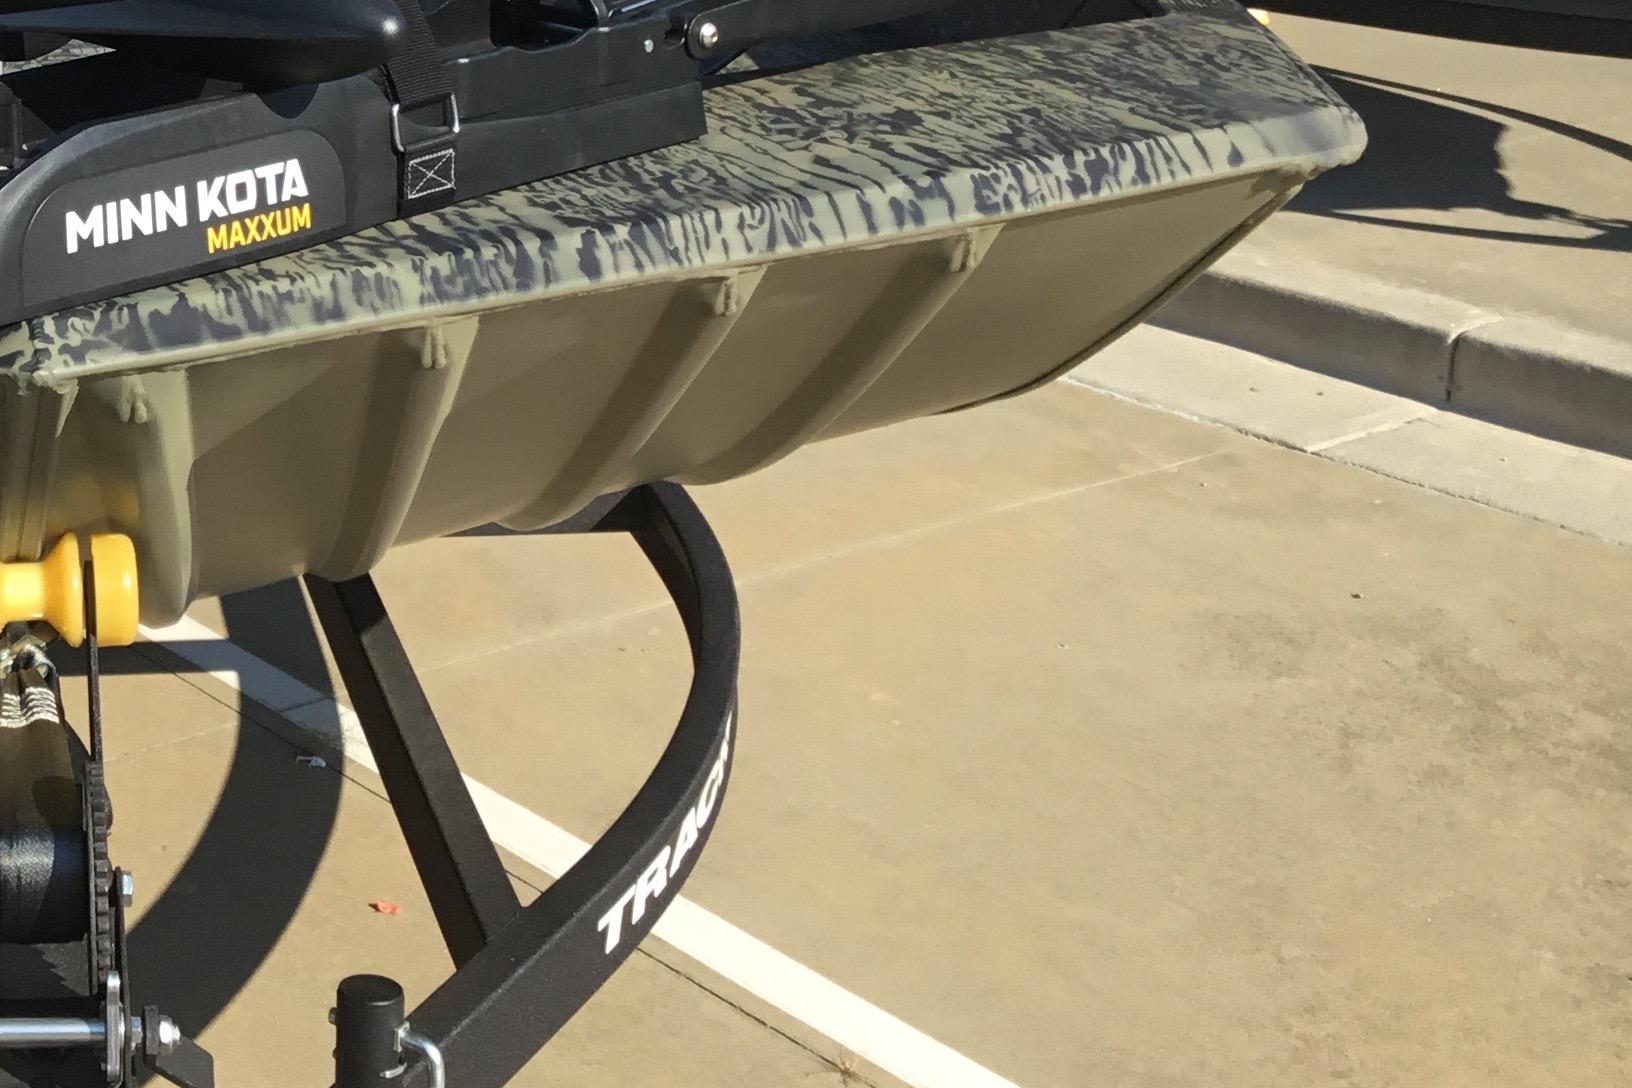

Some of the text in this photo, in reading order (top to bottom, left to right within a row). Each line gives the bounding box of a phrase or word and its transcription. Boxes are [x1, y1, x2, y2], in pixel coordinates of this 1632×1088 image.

[65, 158, 309, 254] MINN KOTA
[206, 202, 312, 254] MAXXUM
[597, 710, 733, 955] TRAC
